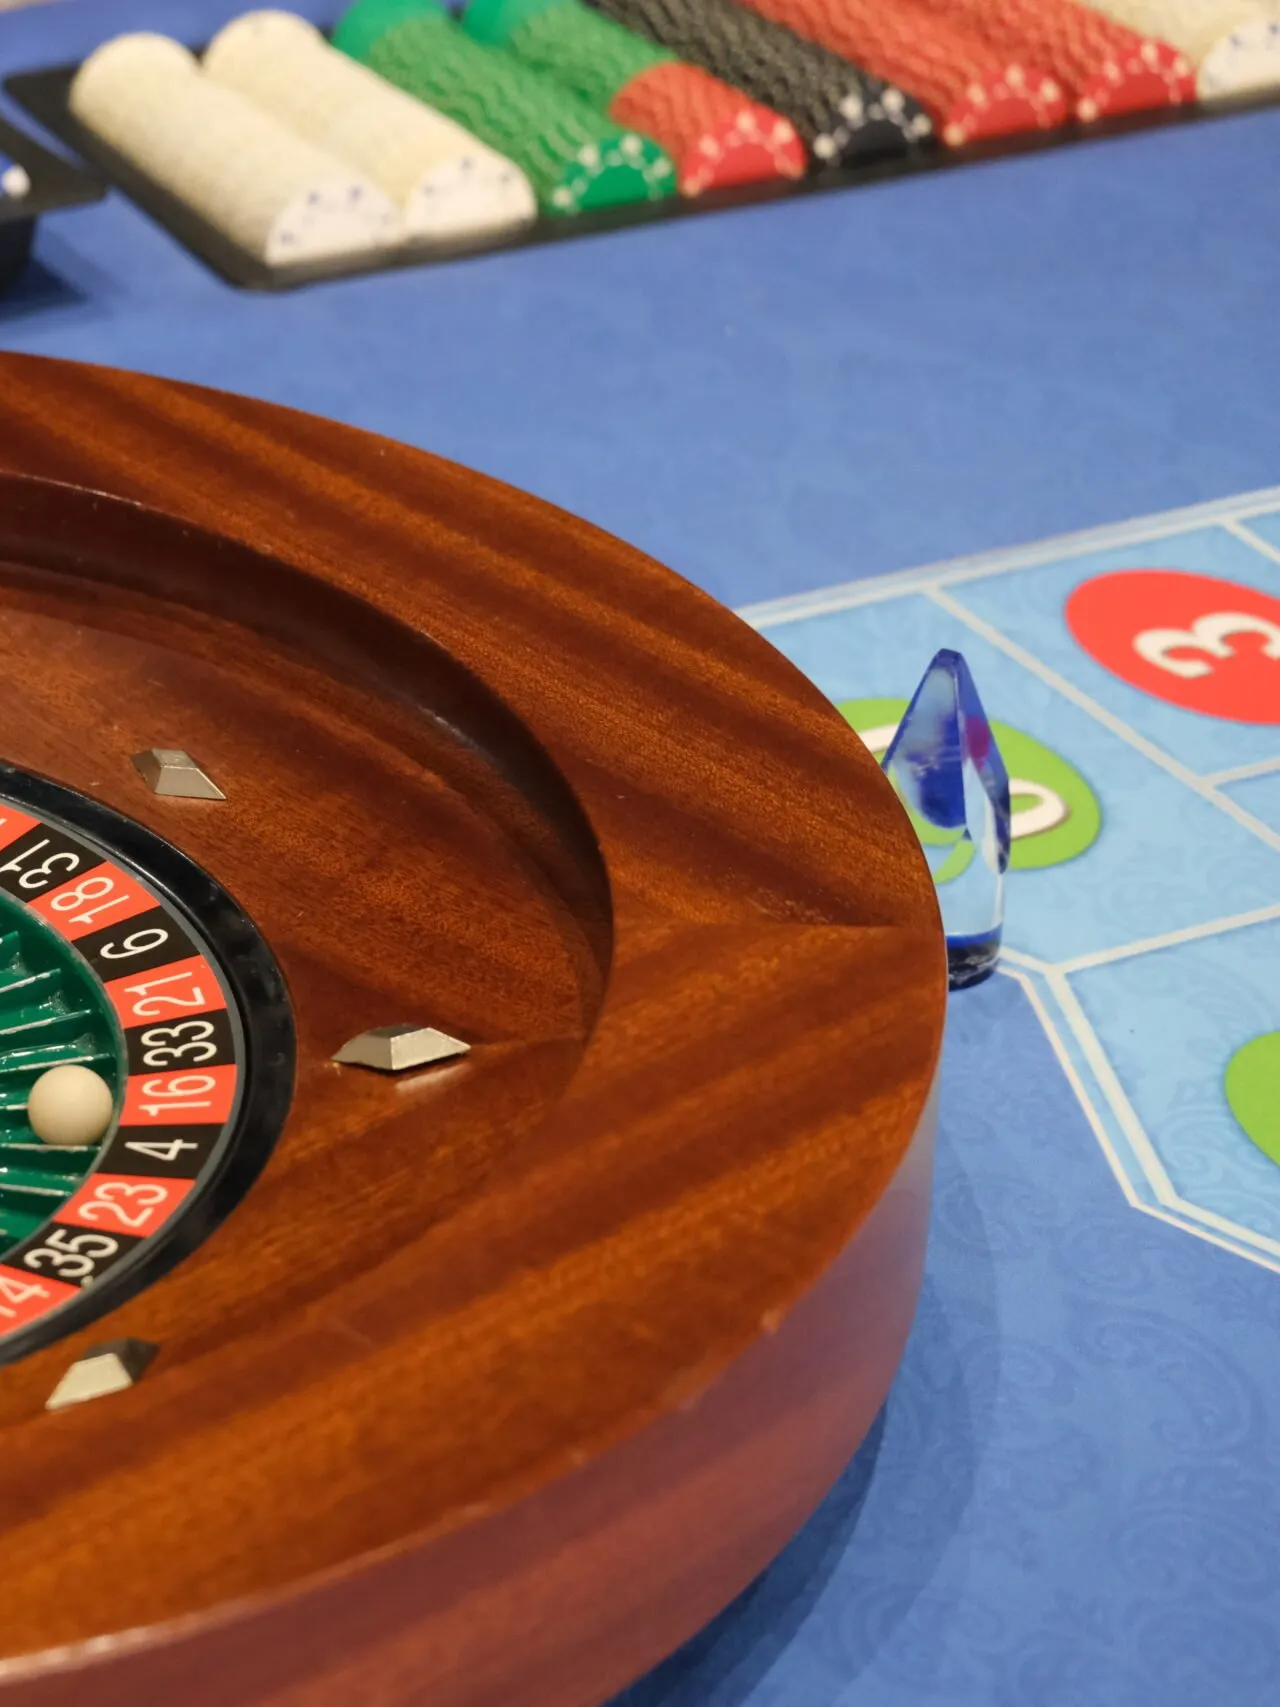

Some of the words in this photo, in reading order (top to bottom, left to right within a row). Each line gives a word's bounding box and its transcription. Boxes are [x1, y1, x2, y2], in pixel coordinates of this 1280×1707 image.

[1132, 612, 1280, 679] 3
[49, 876, 131, 923] 18
[100, 928, 169, 960] 6
[124, 971, 205, 1016] 21
[141, 1021, 216, 1066] 33
[138, 1073, 214, 1117] 16
[125, 1139, 199, 1161] 4
[79, 1181, 168, 1226] 23
[24, 1229, 119, 1279] 35
